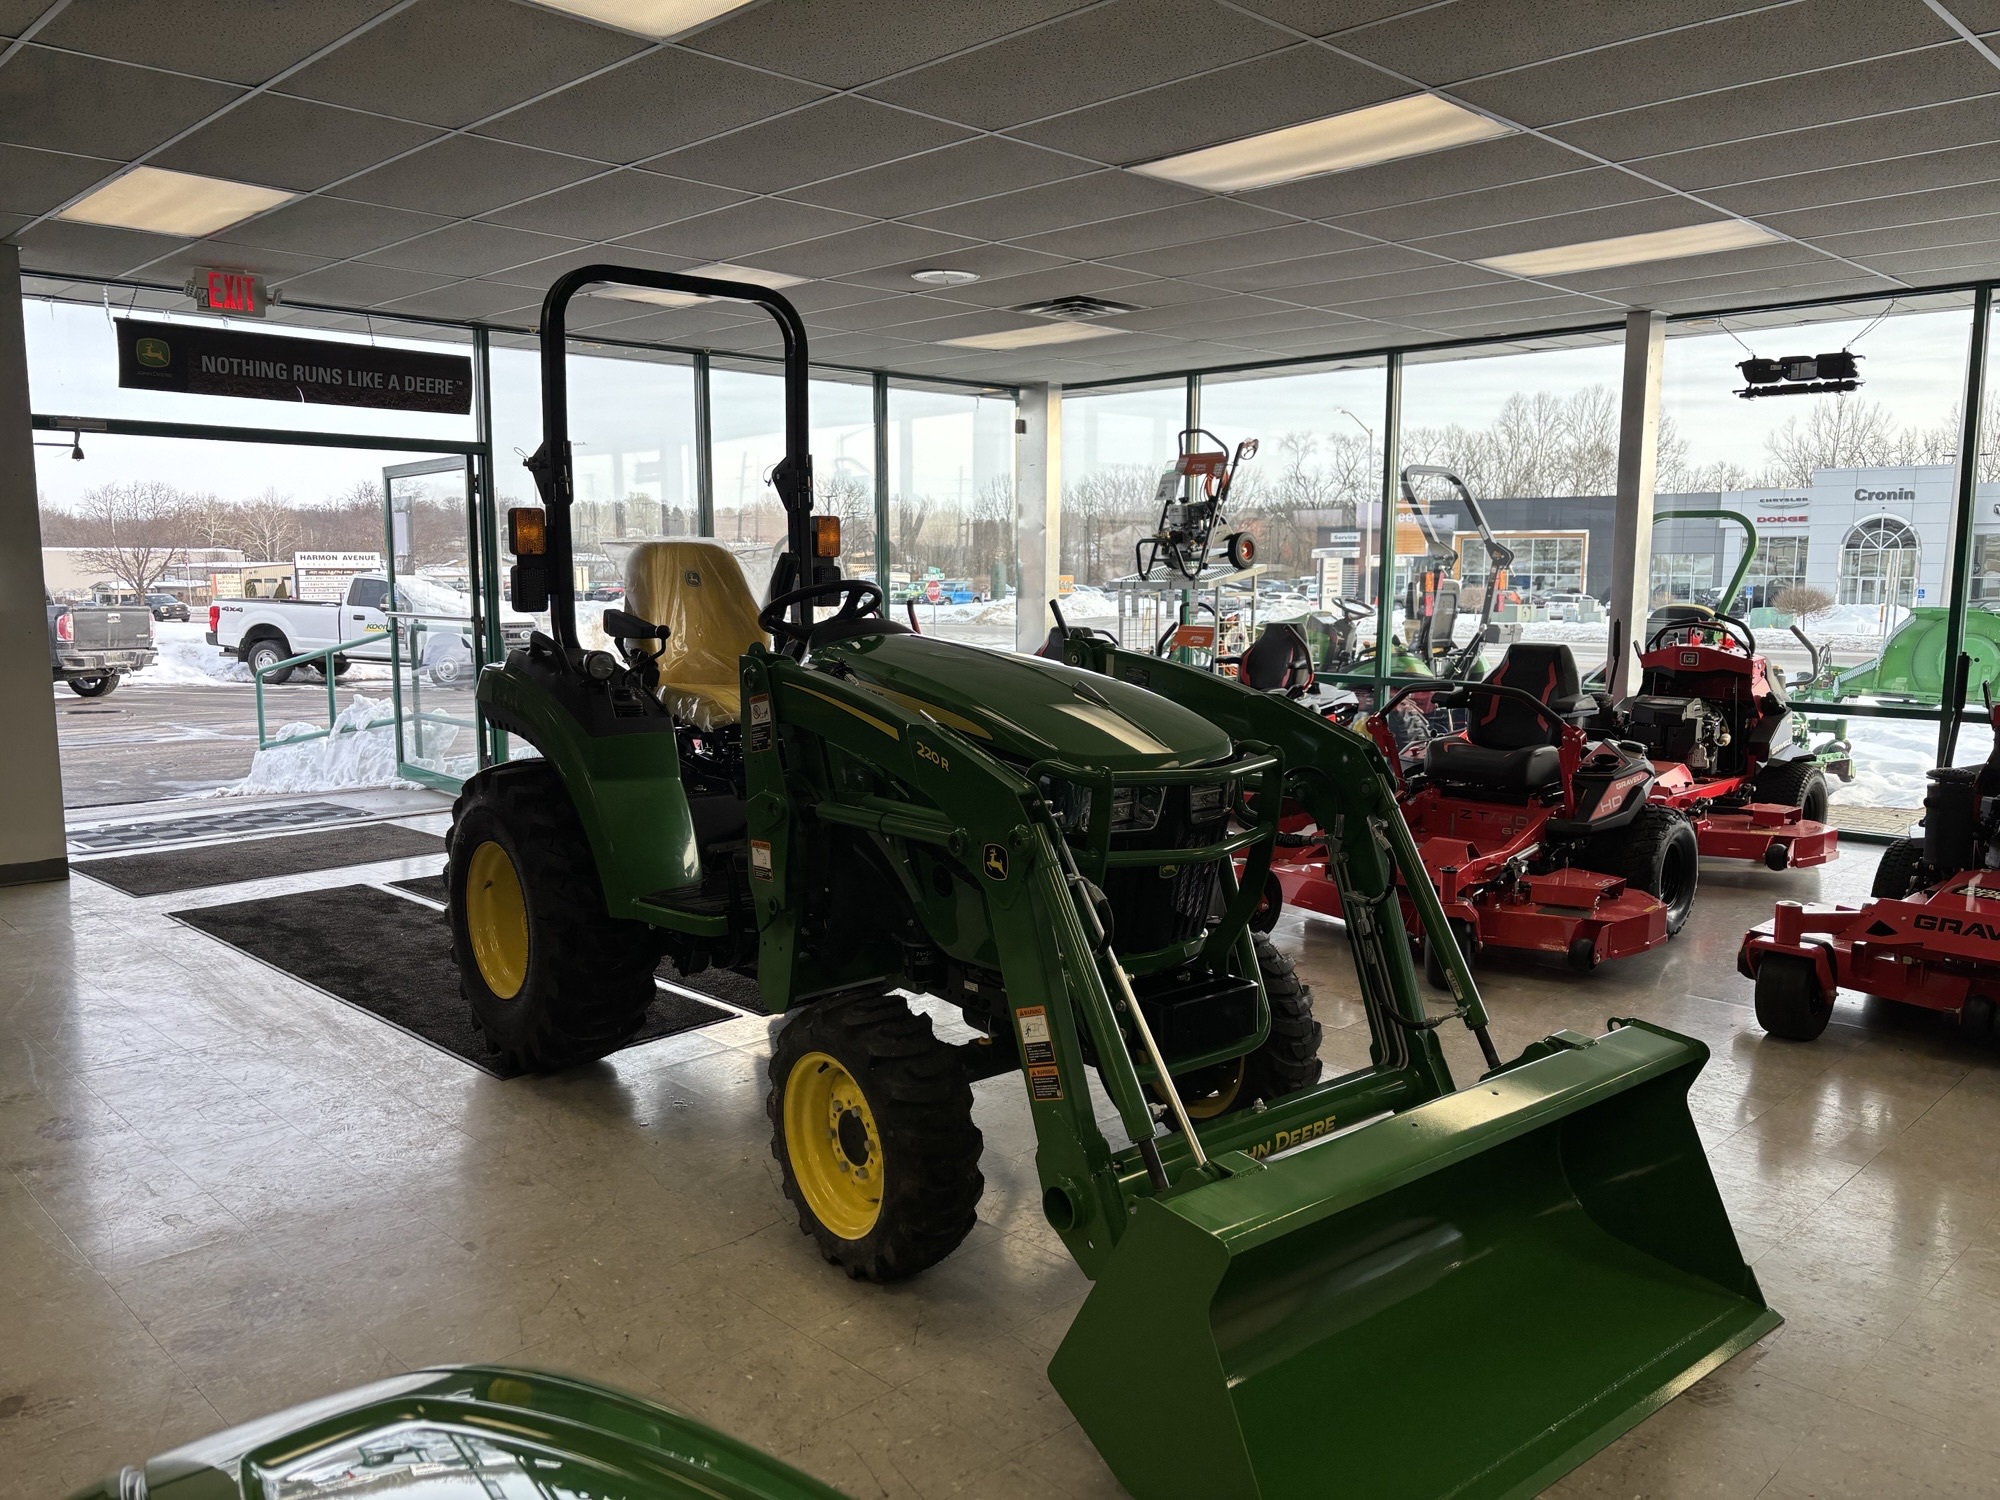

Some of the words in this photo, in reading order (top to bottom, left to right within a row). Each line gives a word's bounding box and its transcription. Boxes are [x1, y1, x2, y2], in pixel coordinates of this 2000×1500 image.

[208, 272, 255, 312] EXIT
[201, 355, 288, 380] NOTHING
[293, 364, 342, 385] RUNS
[347, 370, 384, 389] LIKE
[388, 374, 400, 391] A
[1854, 488, 1915, 501] Cronin
[1615, 774, 1644, 790] GRAVELY
[1600, 795, 1623, 813] HD
[1245, 1140, 1271, 1159] HN
[1275, 1115, 1336, 1153] DEERE
